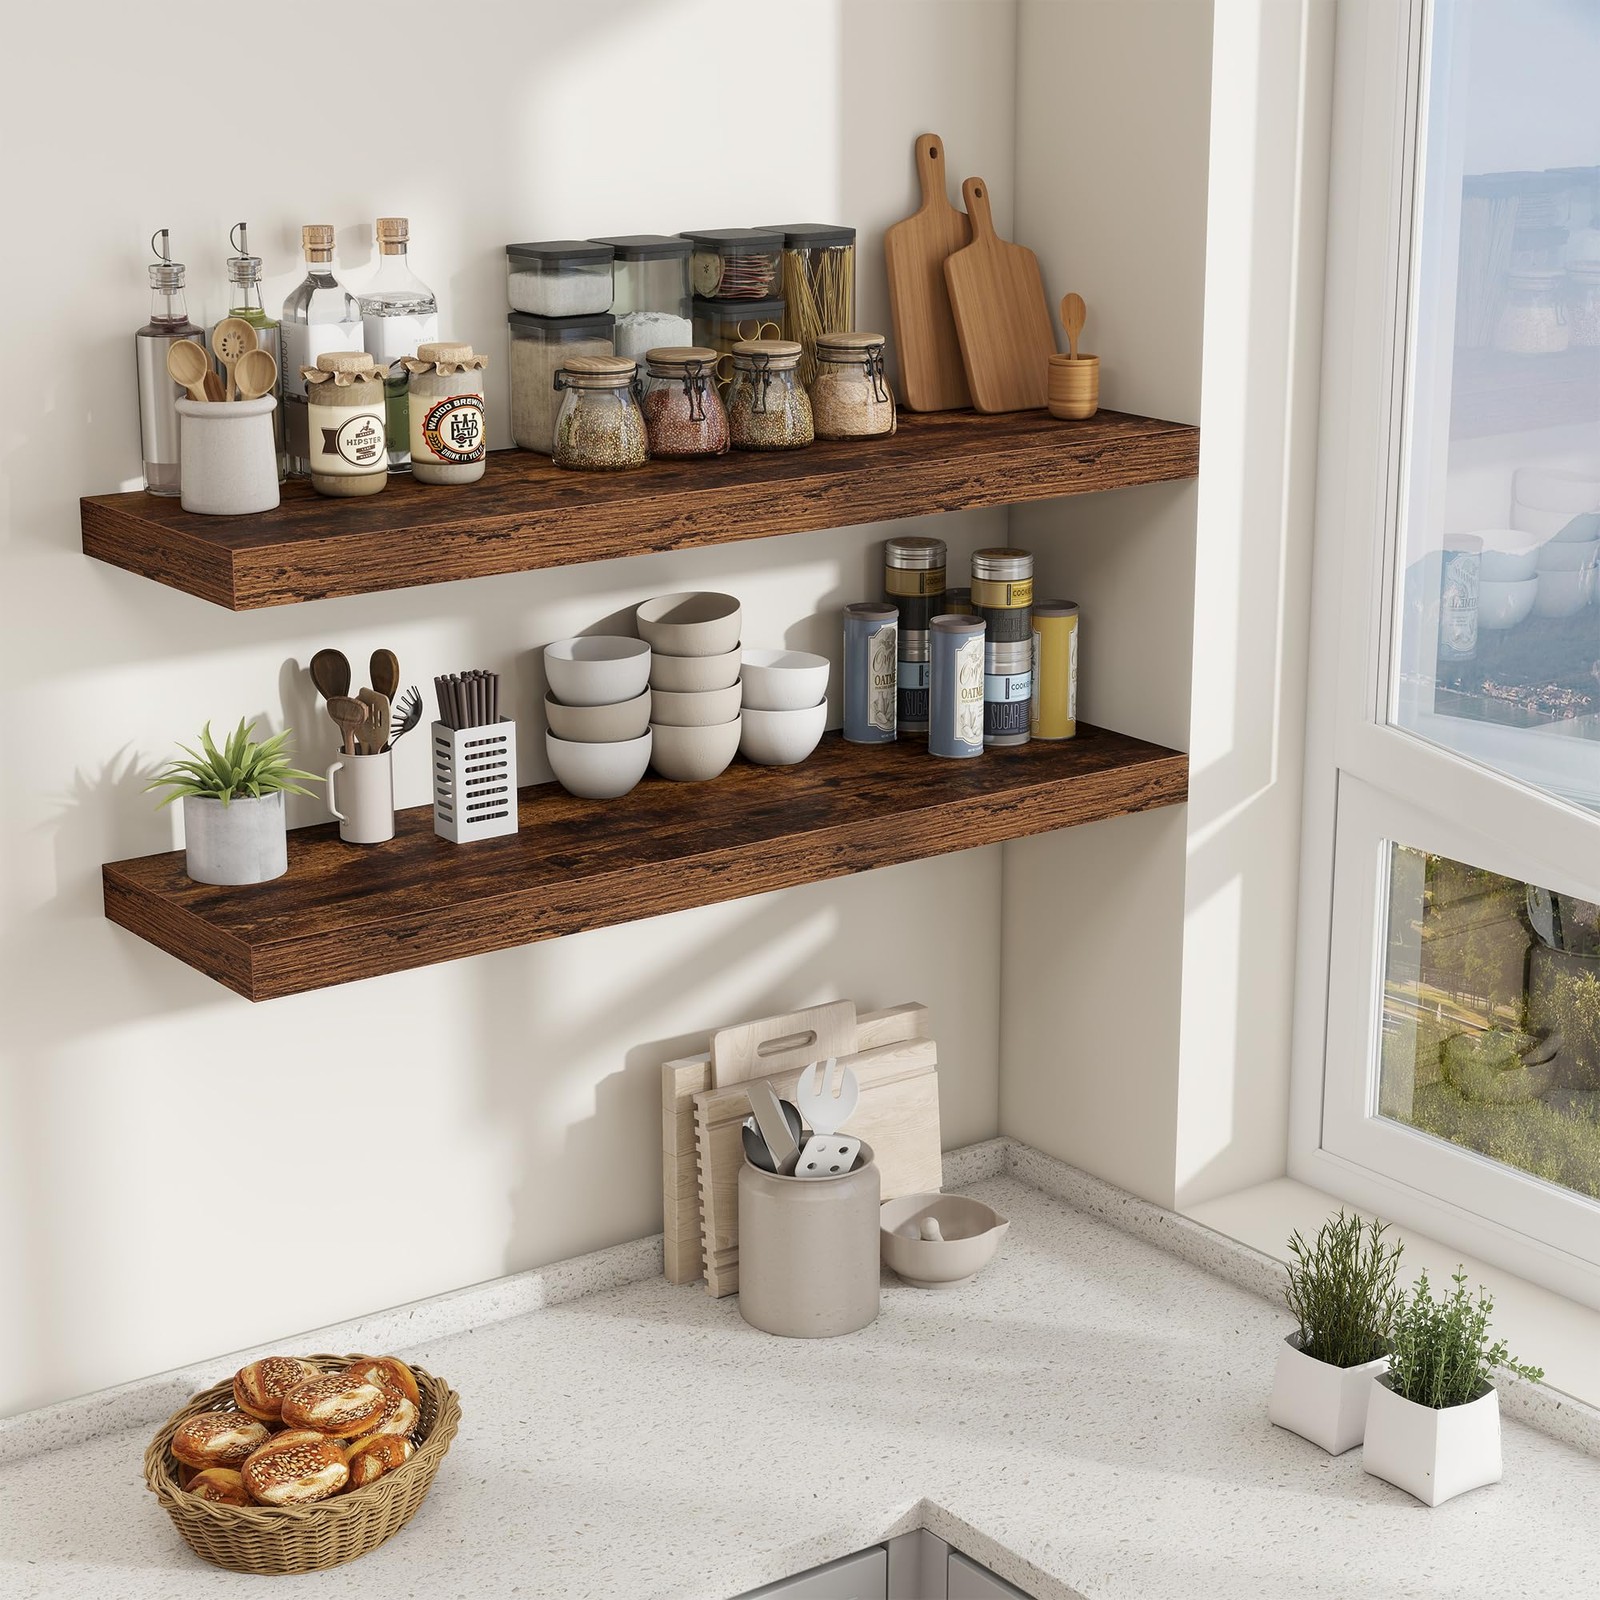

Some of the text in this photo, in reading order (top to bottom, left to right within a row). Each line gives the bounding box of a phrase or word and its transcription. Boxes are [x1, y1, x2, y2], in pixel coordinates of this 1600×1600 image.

[427, 403, 452, 430] WAHOO
[346, 436, 382, 446] HIPSTER
[441, 448, 461, 461] DRINK
[990, 703, 1020, 730] SUGAR
